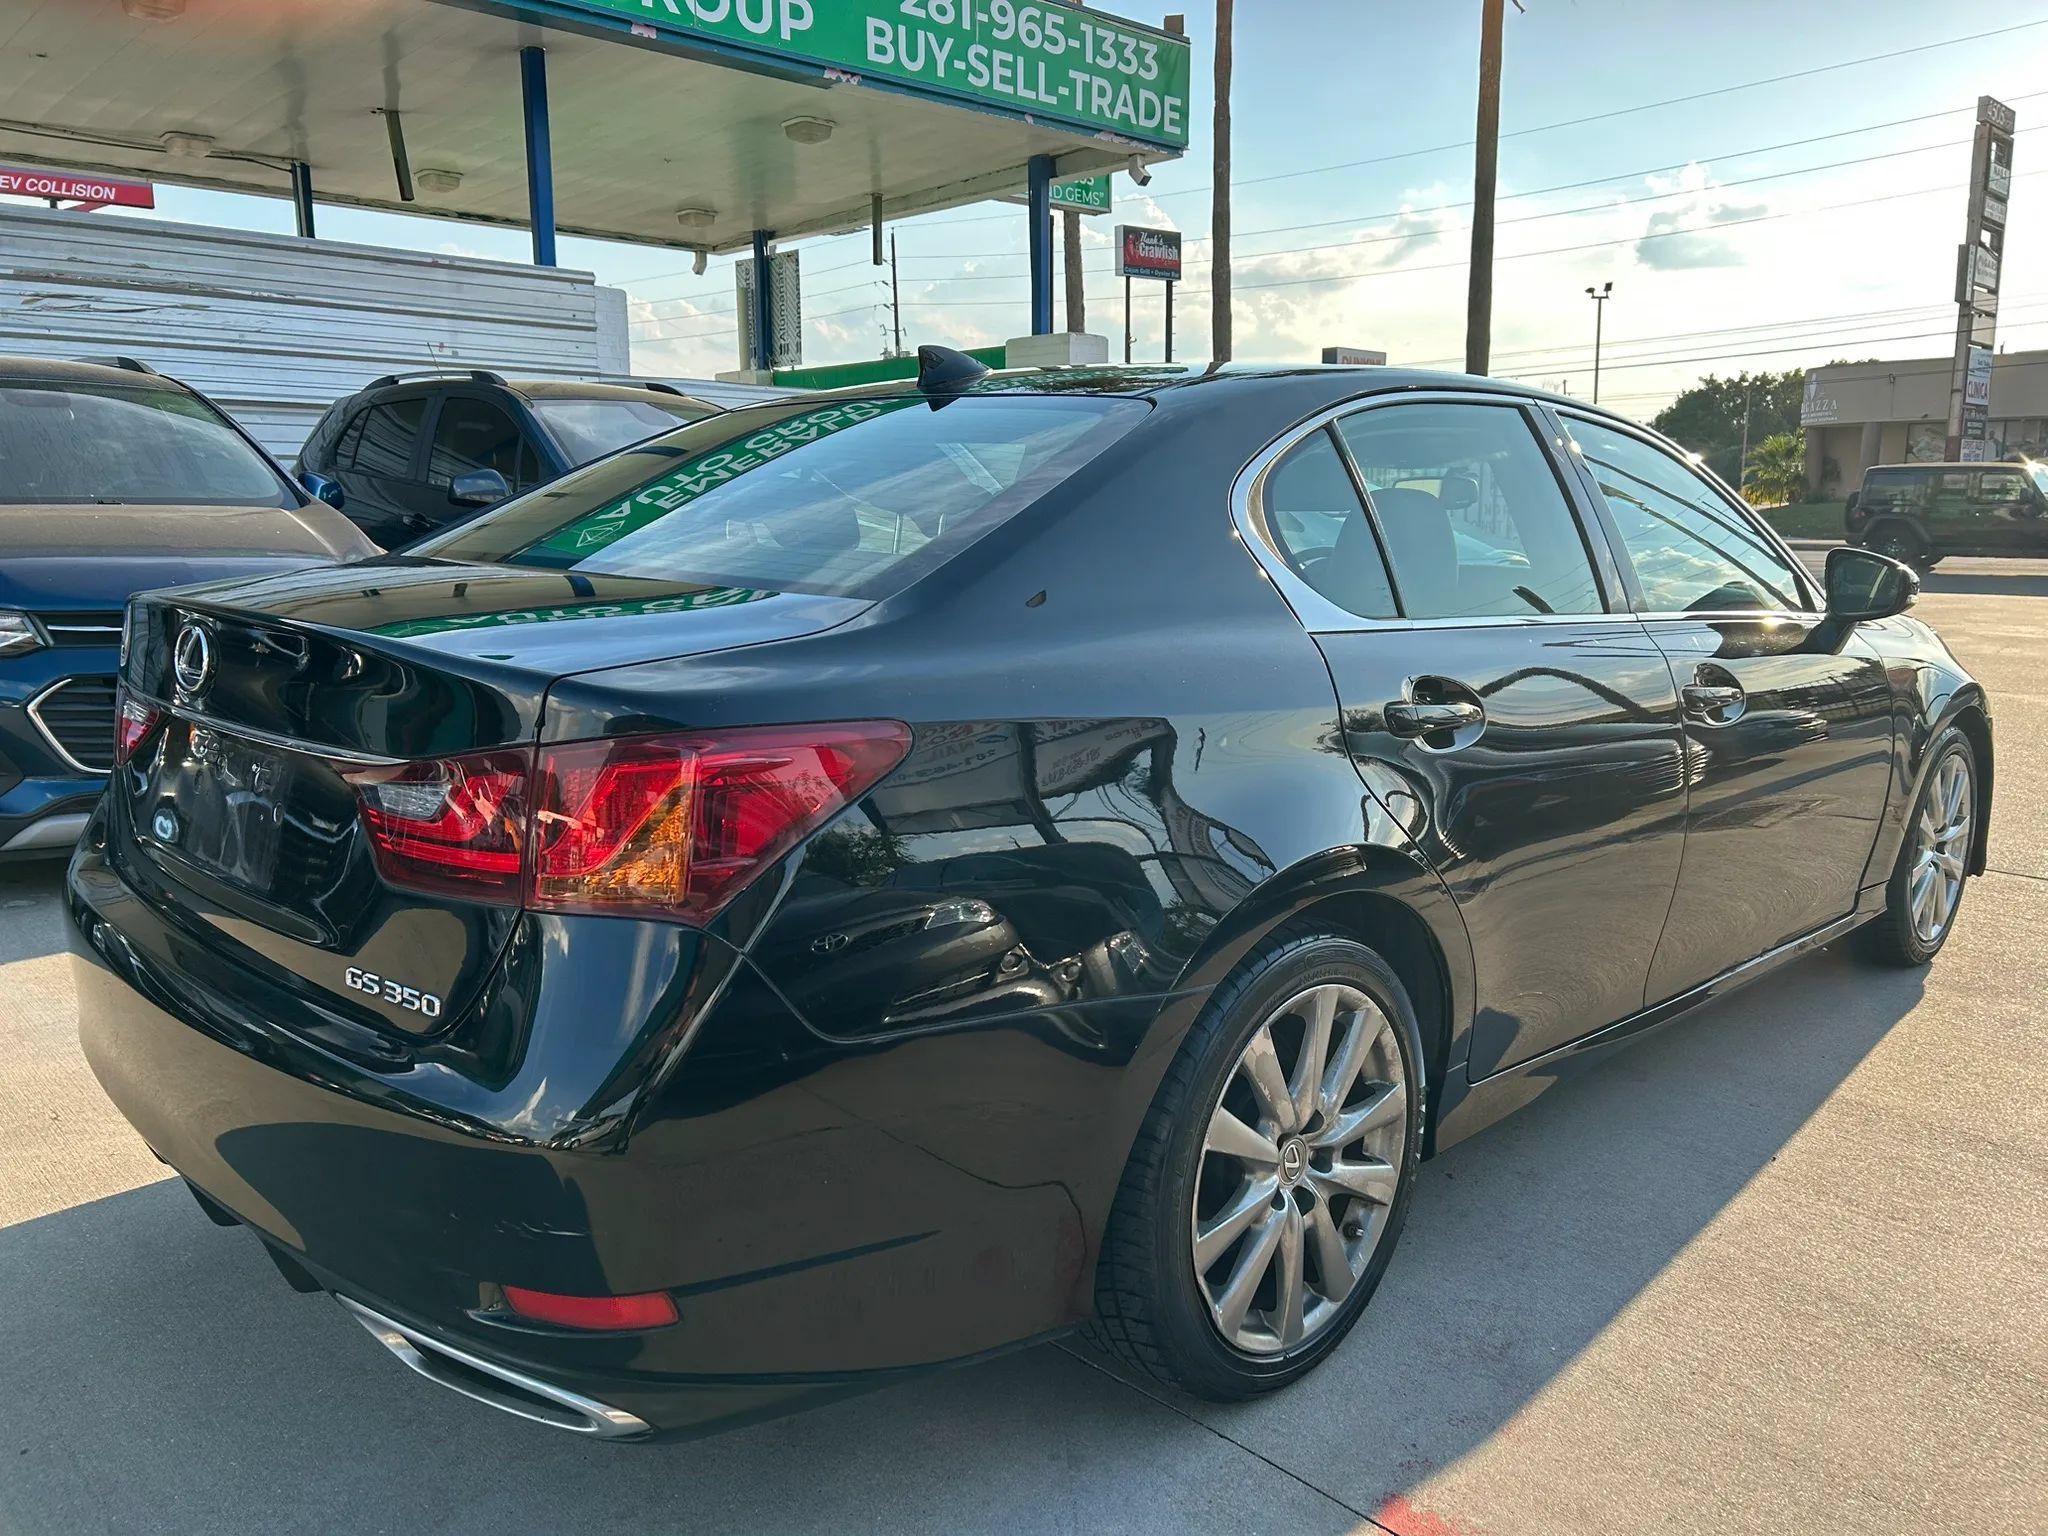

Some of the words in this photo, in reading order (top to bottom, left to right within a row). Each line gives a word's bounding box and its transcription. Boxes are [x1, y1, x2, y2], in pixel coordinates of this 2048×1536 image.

[866, 16, 1182, 135] BUY-SELL-TRADE
[26, 178, 116, 199] COLLISION
[1049, 184, 1063, 199] D
[345, 967, 380, 994] GS
[383, 980, 441, 1017] 350
